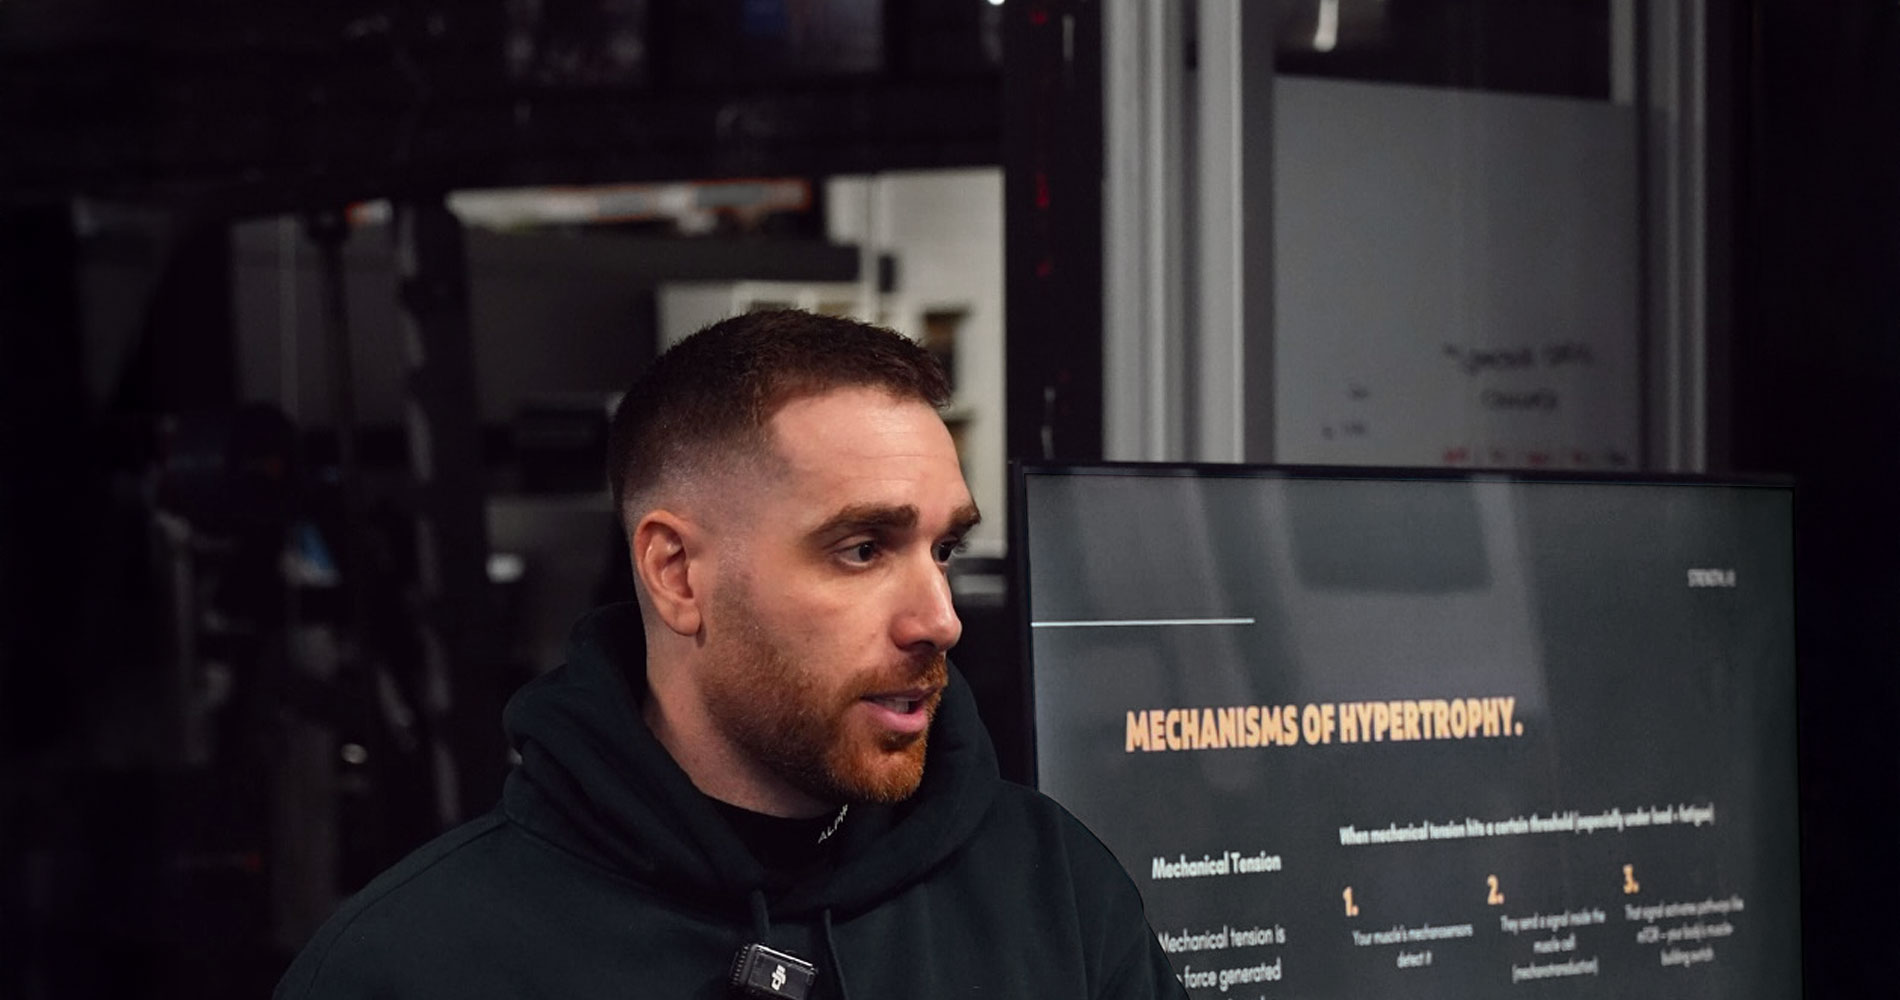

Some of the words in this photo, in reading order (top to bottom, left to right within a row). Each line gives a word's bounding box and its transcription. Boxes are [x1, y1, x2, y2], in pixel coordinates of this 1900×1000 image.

[1126, 705, 1299, 752] MECHANISMS
[1302, 703, 1335, 745] OF
[1339, 696, 1523, 743] HYPERTROPHY.
[1339, 825, 1369, 845] When
[1370, 821, 1429, 843] mechanical
[1430, 821, 1465, 839] tension
[1466, 818, 1485, 836] hits
[1486, 822, 1494, 835] a
[1494, 816, 1529, 835] certain
[1530, 812, 1573, 832] threshold
[1624, 807, 1650, 826] under
[1152, 851, 1229, 879] Mechanical
[1231, 851, 1281, 873] Tension
[1623, 864, 1639, 893] 3.
[1343, 887, 1359, 916] 1.
[1487, 875, 1504, 904] 2.
[1158, 925, 1228, 952] Mechanical
[1230, 927, 1273, 947] tension
[1275, 924, 1285, 943] is
[1184, 965, 1217, 988] force
[1219, 957, 1282, 992] generated
